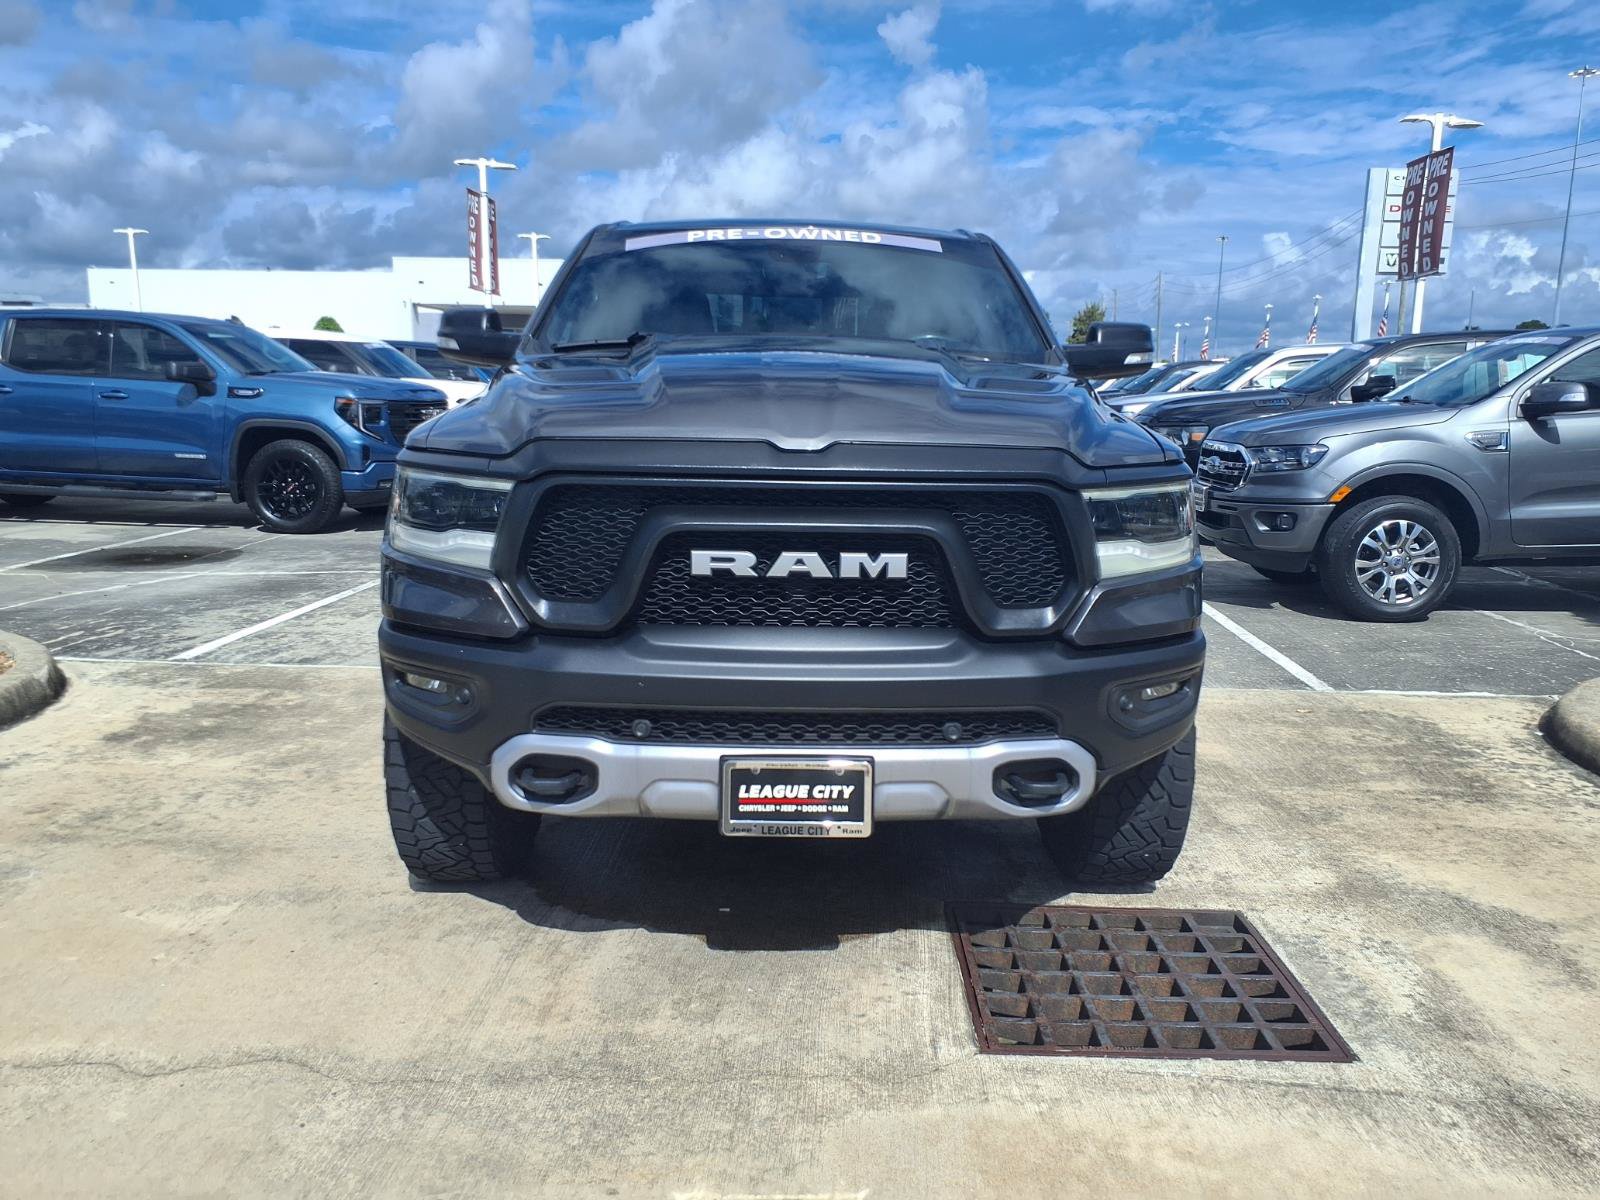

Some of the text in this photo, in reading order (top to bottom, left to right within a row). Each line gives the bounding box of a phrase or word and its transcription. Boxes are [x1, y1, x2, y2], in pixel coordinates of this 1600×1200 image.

[1406, 163, 1424, 188] PRE
[1428, 153, 1450, 180] PRE
[1401, 191, 1414, 275] OWNED
[1423, 182, 1438, 270] OWNED
[691, 550, 909, 578] RAM
[738, 784, 855, 799] LEAGUE CITY
[738, 804, 849, 813] CHRYSLER JEEP DODGE RAM
[761, 826, 806, 835] LEAGUE
[808, 826, 831, 836] CITY
